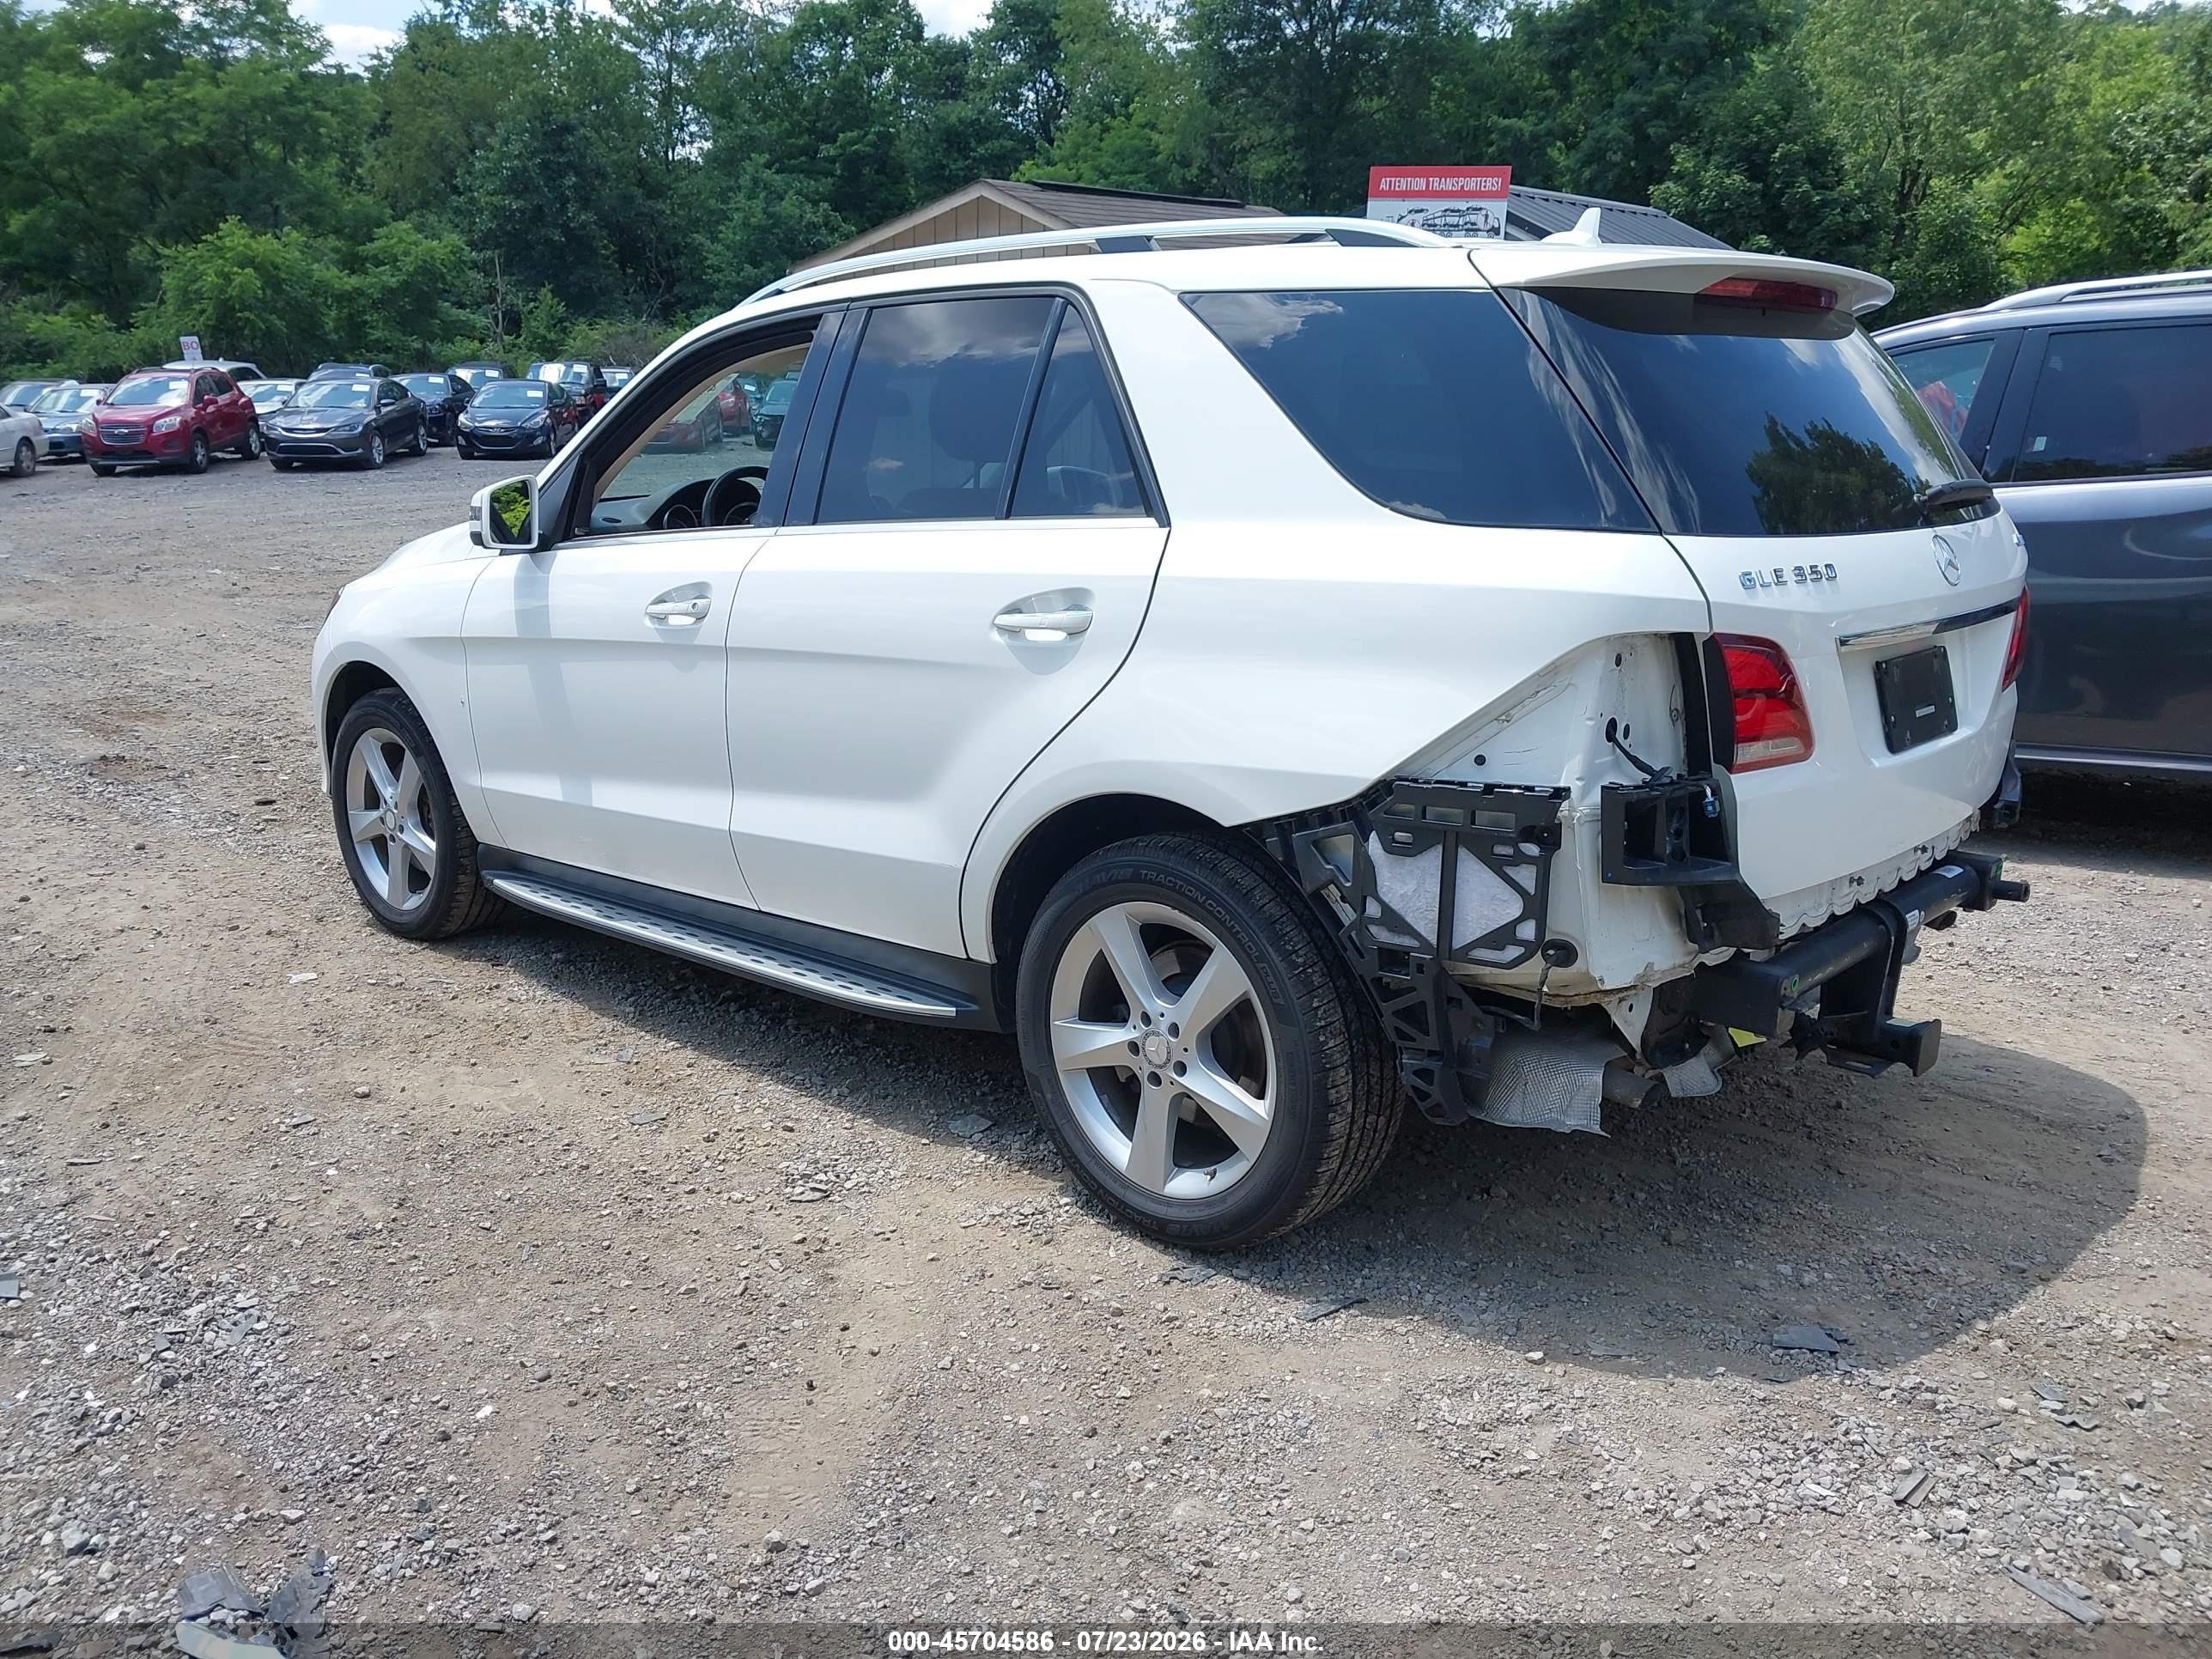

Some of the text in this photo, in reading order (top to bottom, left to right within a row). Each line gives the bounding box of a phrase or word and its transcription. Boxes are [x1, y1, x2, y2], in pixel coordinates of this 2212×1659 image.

[1379, 177, 1503, 191] ATTENTION TRANSPORTERS!
[1739, 563, 1838, 590] GLE 350
[1139, 869, 1206, 904] TRACTION
[1205, 899, 1261, 963] CONTROL
